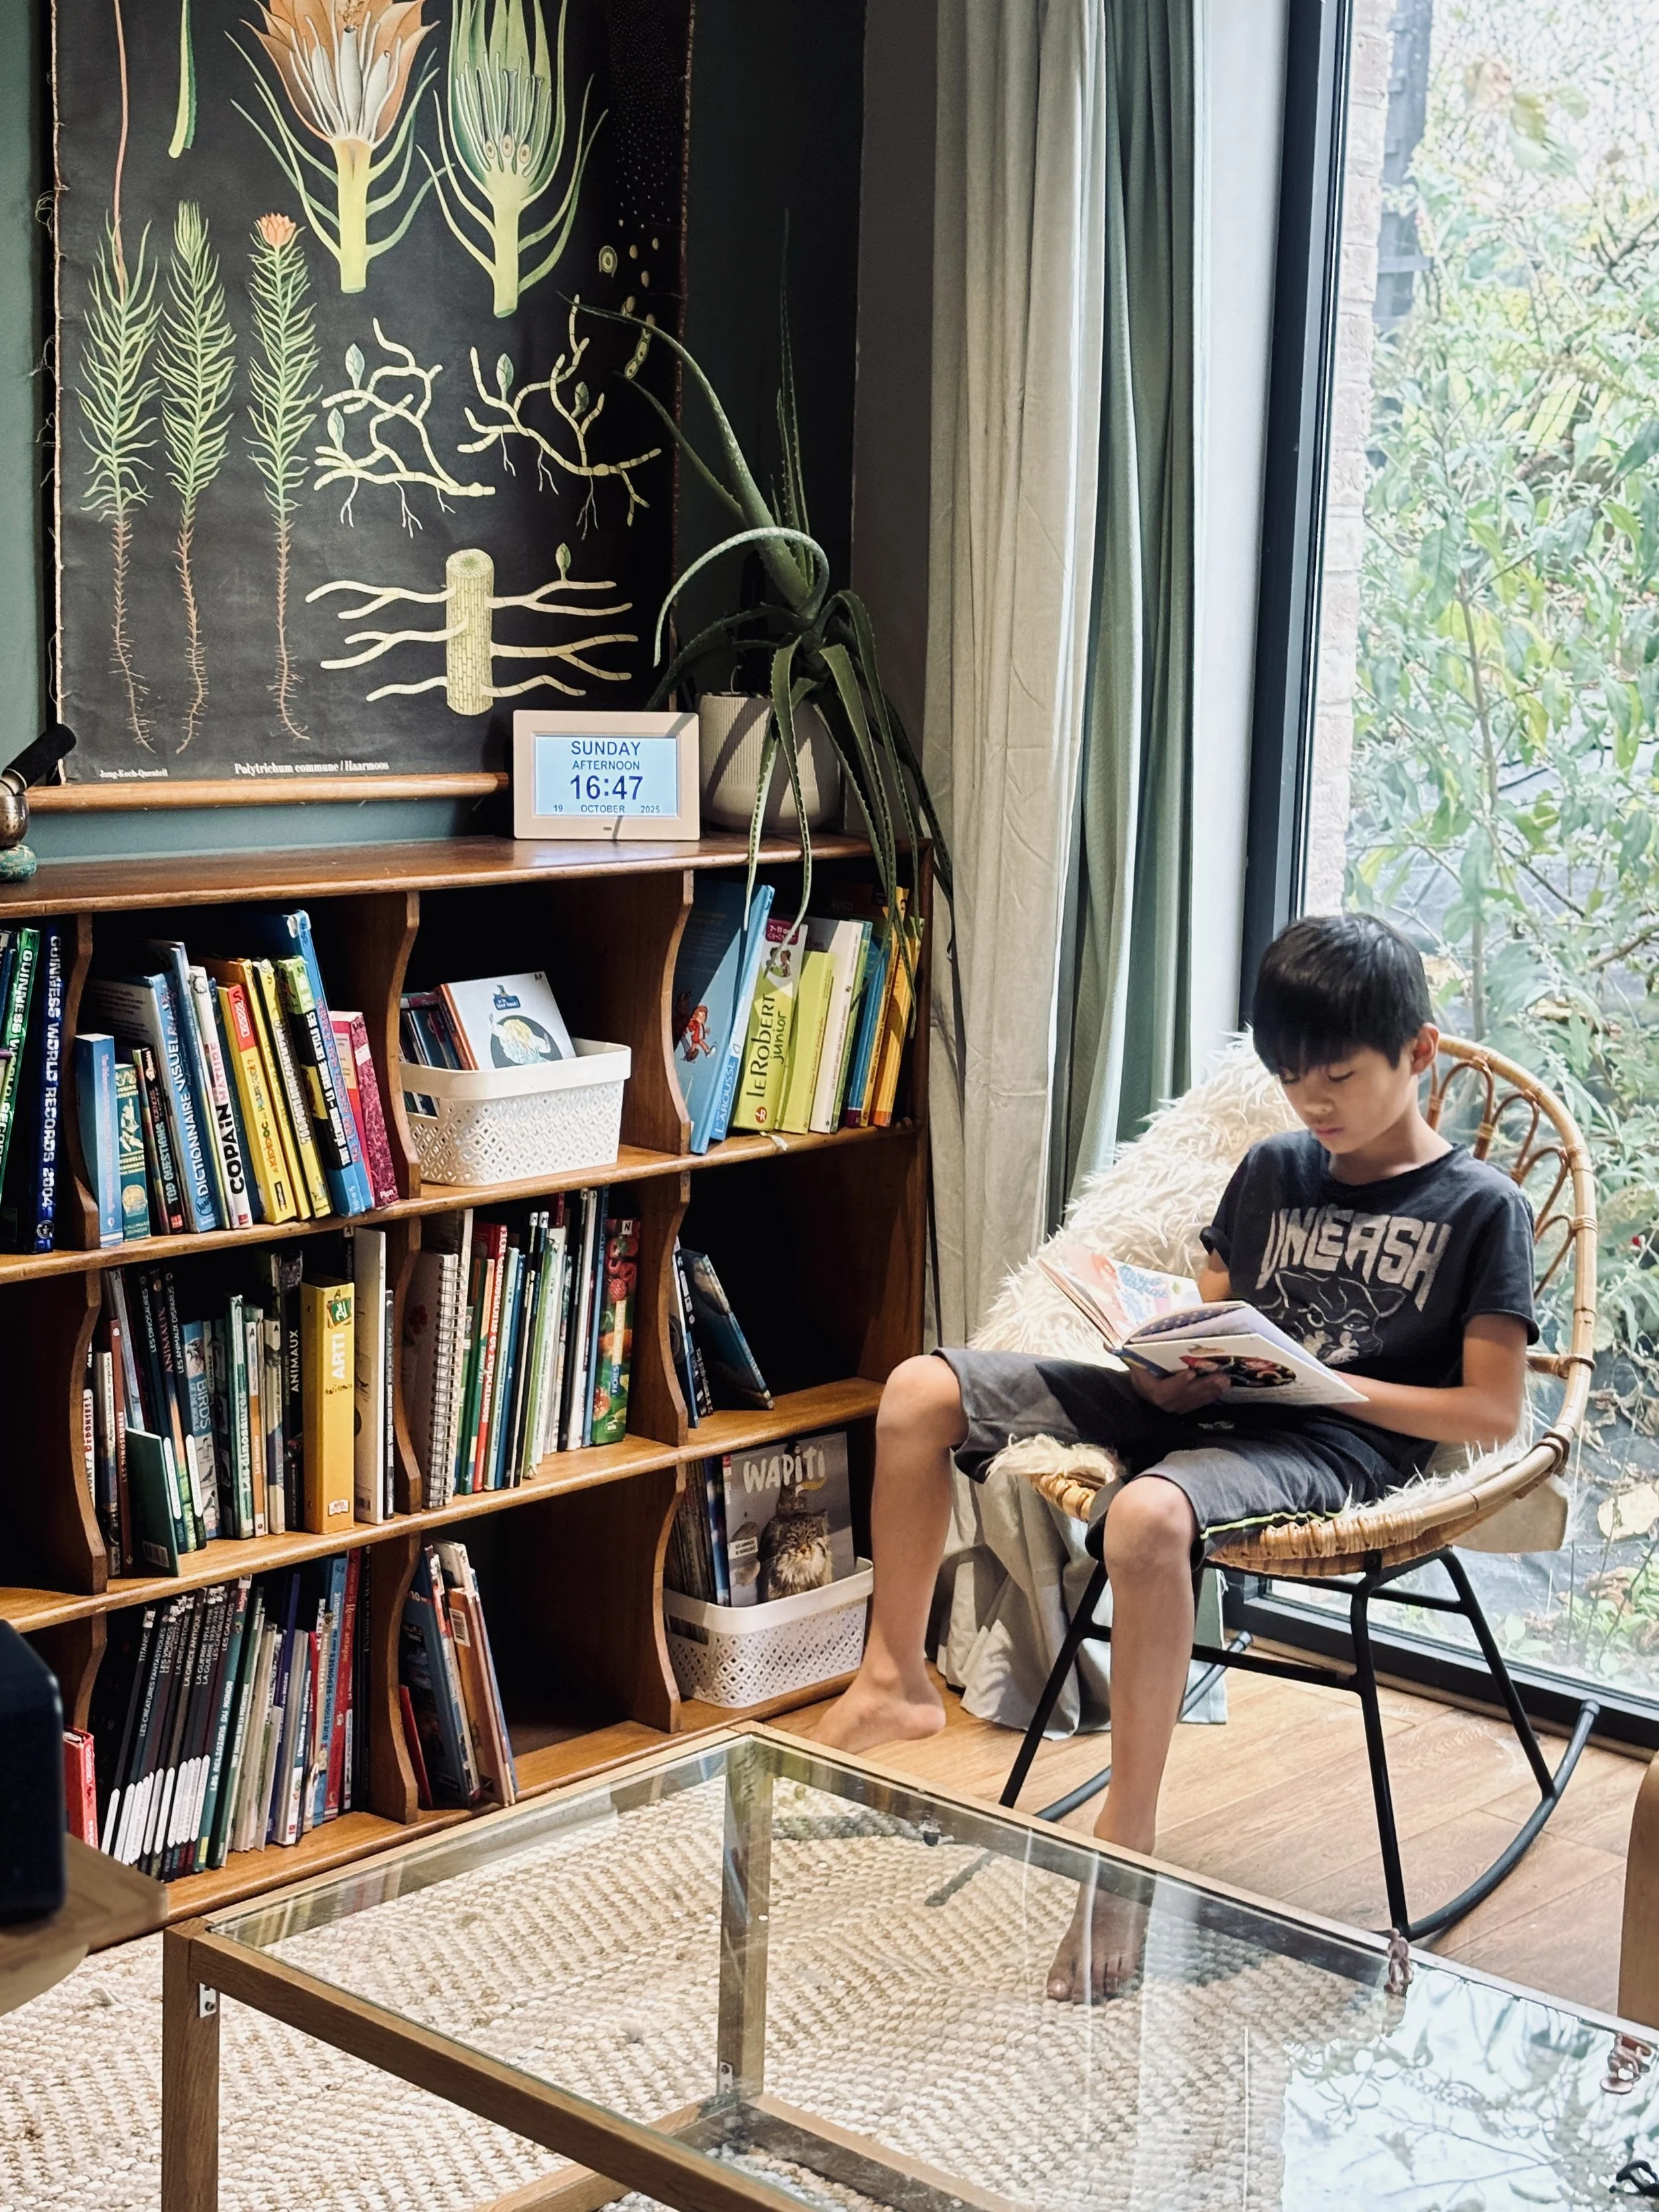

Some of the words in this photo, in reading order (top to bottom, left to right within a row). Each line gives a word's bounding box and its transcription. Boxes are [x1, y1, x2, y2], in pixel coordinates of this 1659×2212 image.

[234, 762, 293, 777] Polytrichum
[295, 763, 339, 772] commune
[345, 760, 390, 771] Haarmoos
[571, 741, 641, 756] SUNDAY
[572, 760, 640, 770] AFTERNOON
[570, 775, 644, 800] 16:47
[581, 804, 625, 813] OCTOBER
[640, 805, 660, 813] 2025
[11, 949, 33, 1034] GUINNESS
[47, 935, 62, 1018] GUINNESS
[46, 1022, 60, 1082] WORLD
[770, 1011, 788, 1064] junior
[168, 1035, 186, 1092] VISUEL
[715, 1060, 736, 1135] LAROUSSE
[43, 1086, 57, 1162] RECORDS
[180, 1091, 209, 1197] DICTIONNAIRE
[155, 1122, 174, 1181] QUESTIONS
[42, 1168, 55, 1208] 2004
[166, 1183, 179, 1204] TOP
[1255, 1204, 1452, 1312] UNLEASH
[141, 1287, 154, 1338] DINOSAURES
[166, 1285, 179, 1323] DISPARUS
[157, 1306, 174, 1373] ANIMAUX
[171, 1323, 182, 1358] ANIMAUX
[289, 1329, 299, 1392] ANIMAUX
[331, 1332, 346, 1380] ARTI
[194, 1378, 212, 1429] BIRDS
[117, 1411, 127, 1465] DINOSAURES
[236, 1390, 250, 1466] dinosaures
[240, 1467, 251, 1491] Les
[175, 1613, 190, 1663] PRÉHISTOIRE
[213, 1604, 227, 1646] CHEVALIERS
[222, 1602, 235, 1635] GAULOIS
[137, 1631, 150, 1662] TITANIC
[149, 1627, 166, 1681] FANTASTIQUES
[161, 1625, 175, 1659] VIKINGS
[182, 1675, 190, 1687] LA
[189, 1614, 202, 1649] ANTIQUE
[196, 1641, 208, 1674] GUERRE
[203, 1643, 214, 1674] GUERRE
[221, 1635, 230, 1651] LES
[175, 1664, 182, 1675] LA
[194, 1673, 202, 1685] LA
[200, 1673, 209, 1685] LA
[139, 1680, 156, 1722] CRÉATURES
[139, 1722, 147, 1737] LES
[212, 1723, 226, 1773] RELIGIONS
[220, 1709, 229, 1722] DU
